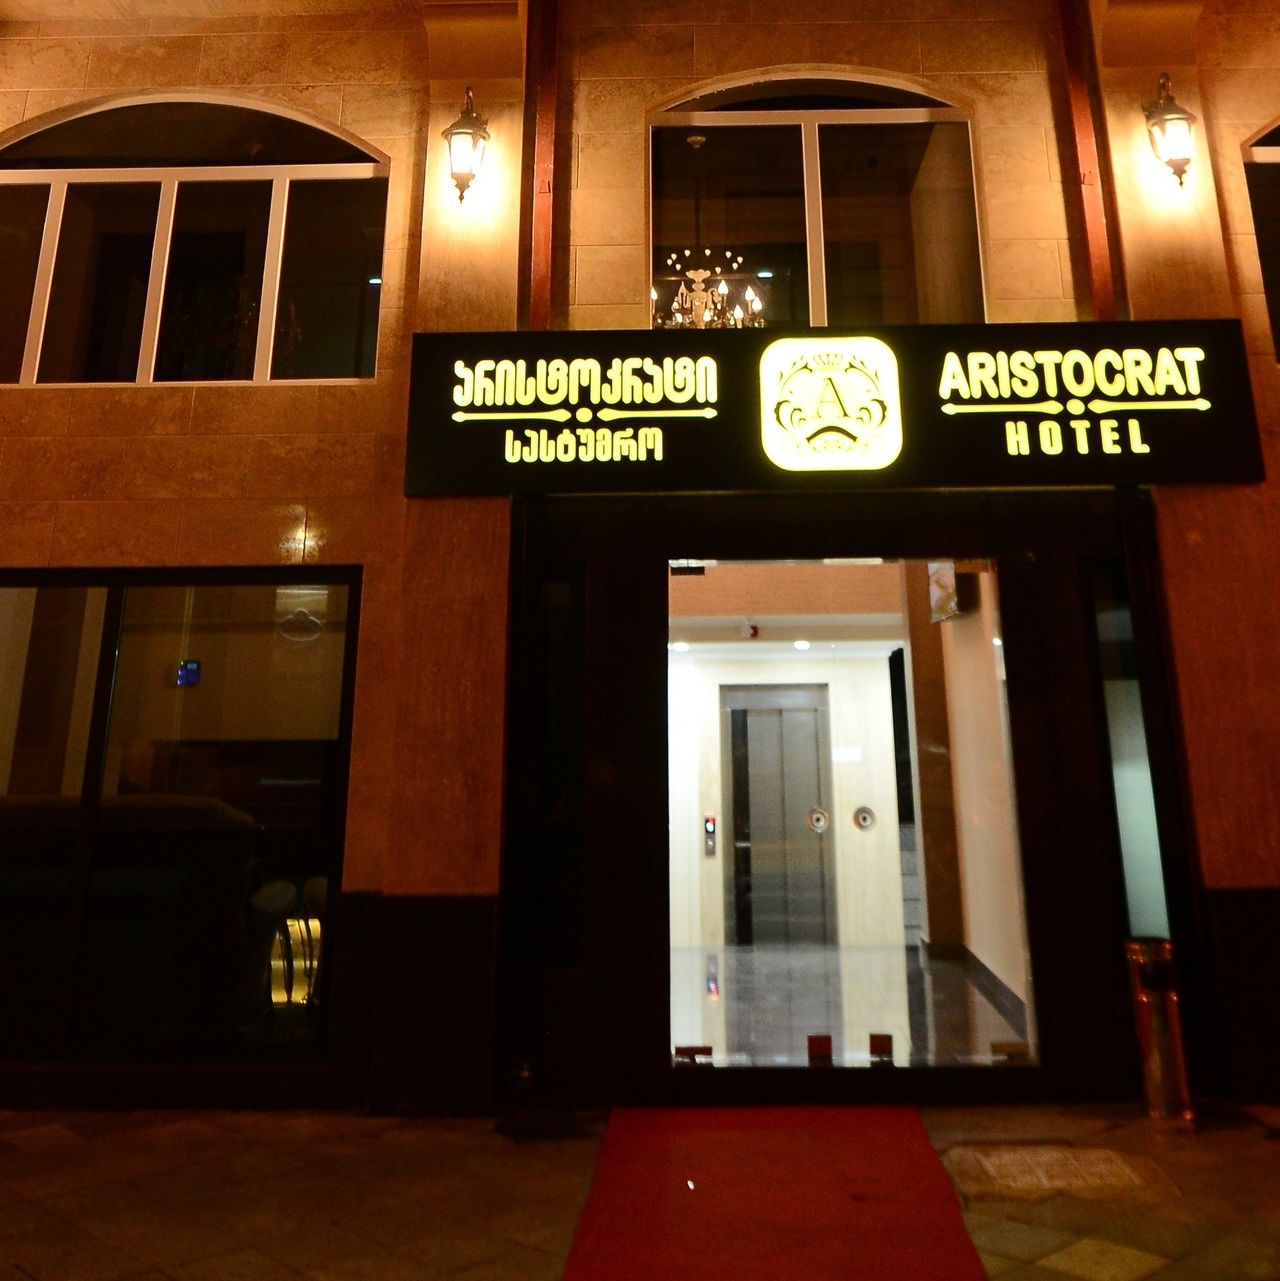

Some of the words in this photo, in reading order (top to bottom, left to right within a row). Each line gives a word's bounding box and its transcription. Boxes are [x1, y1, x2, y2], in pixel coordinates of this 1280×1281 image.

[452, 355, 719, 407] არისტოკრატი
[938, 347, 1206, 400] ARISTOCRAT
[504, 426, 664, 464] სასტუმრო
[1004, 418, 1151, 456] HOTEL
